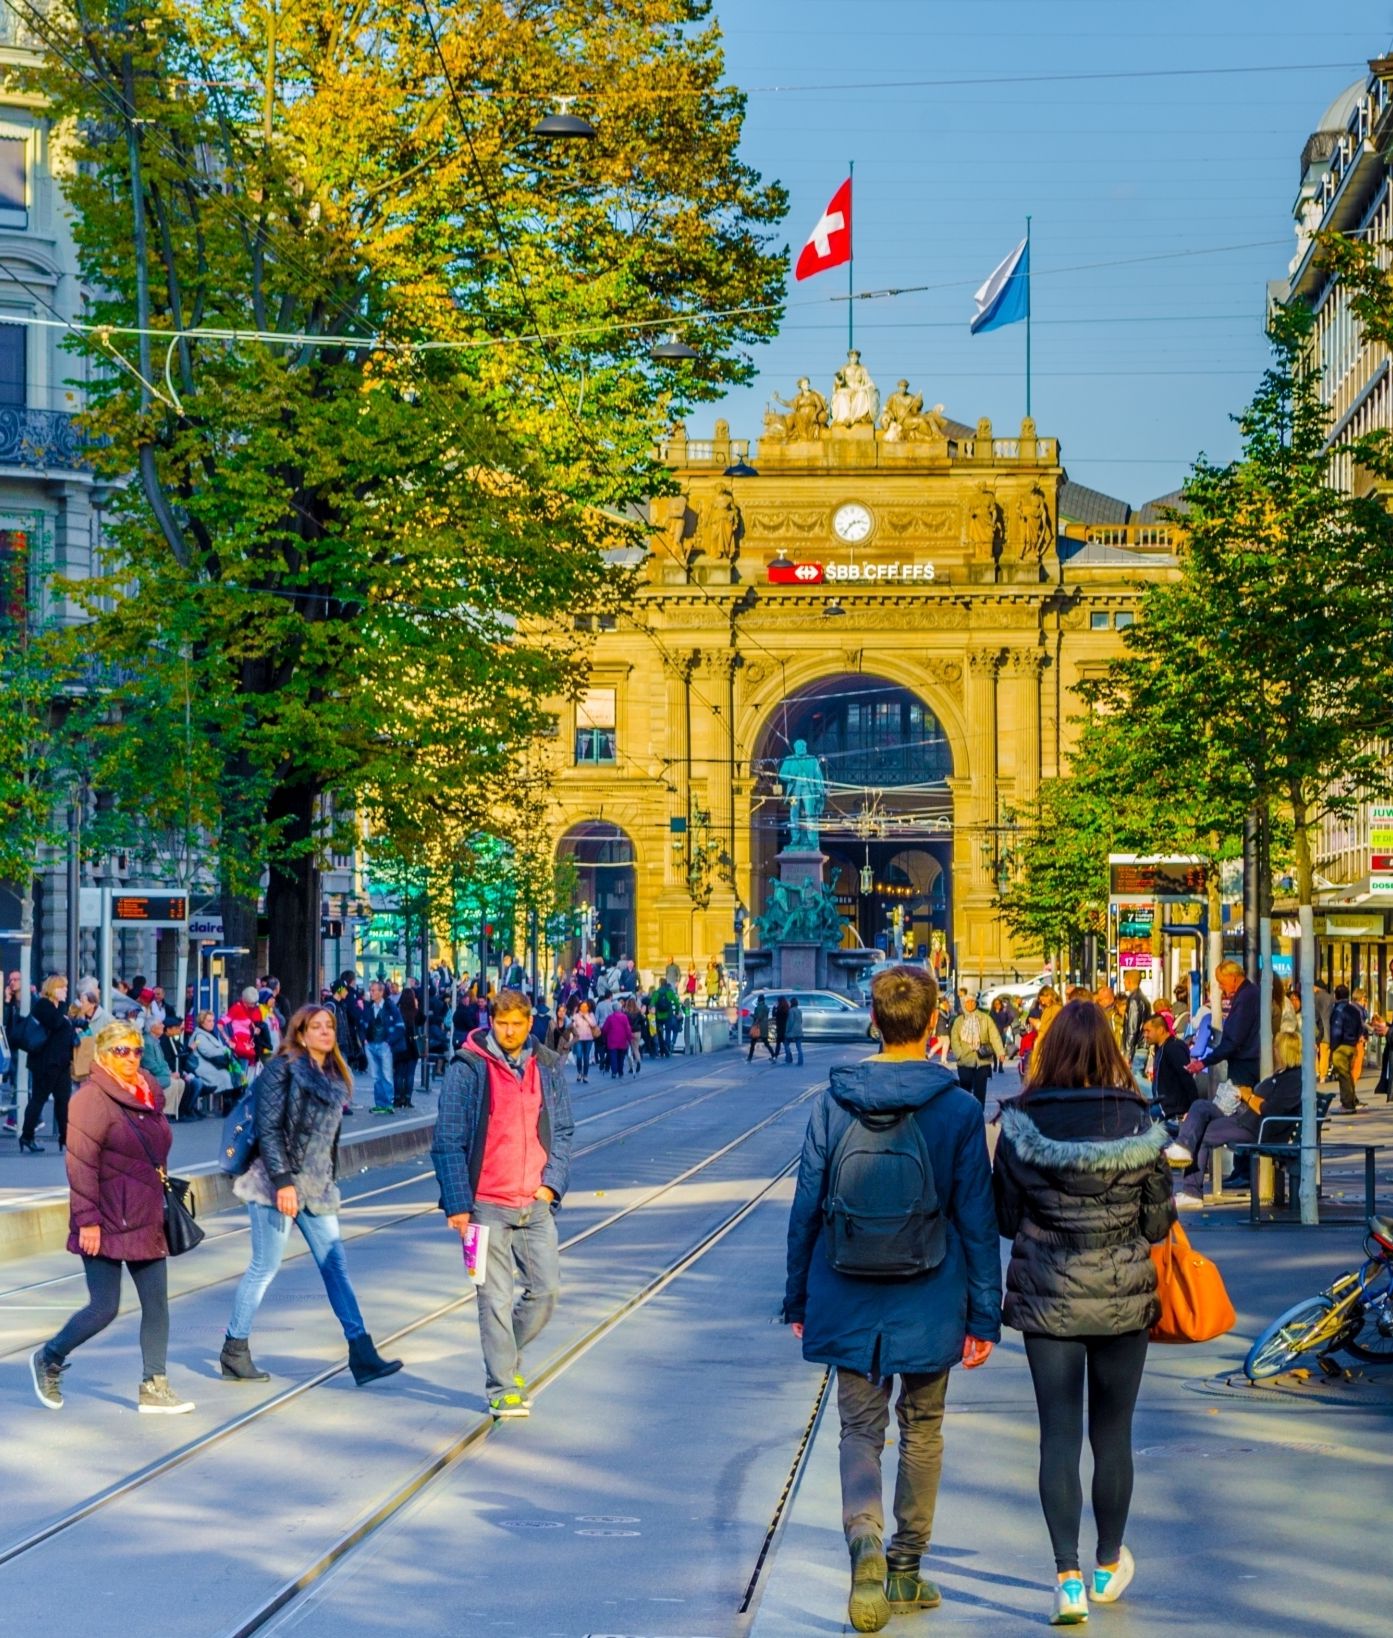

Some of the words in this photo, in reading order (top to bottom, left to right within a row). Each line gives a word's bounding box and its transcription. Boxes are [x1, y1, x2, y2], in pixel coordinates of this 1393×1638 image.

[825, 564, 860, 580] SBB
[864, 564, 898, 580] CFF
[902, 564, 935, 580] FFS
[1127, 913, 1134, 922] 7
[1335, 918, 1374, 927] Läderach
[189, 921, 224, 933] claire
[1124, 957, 1134, 967] 17
